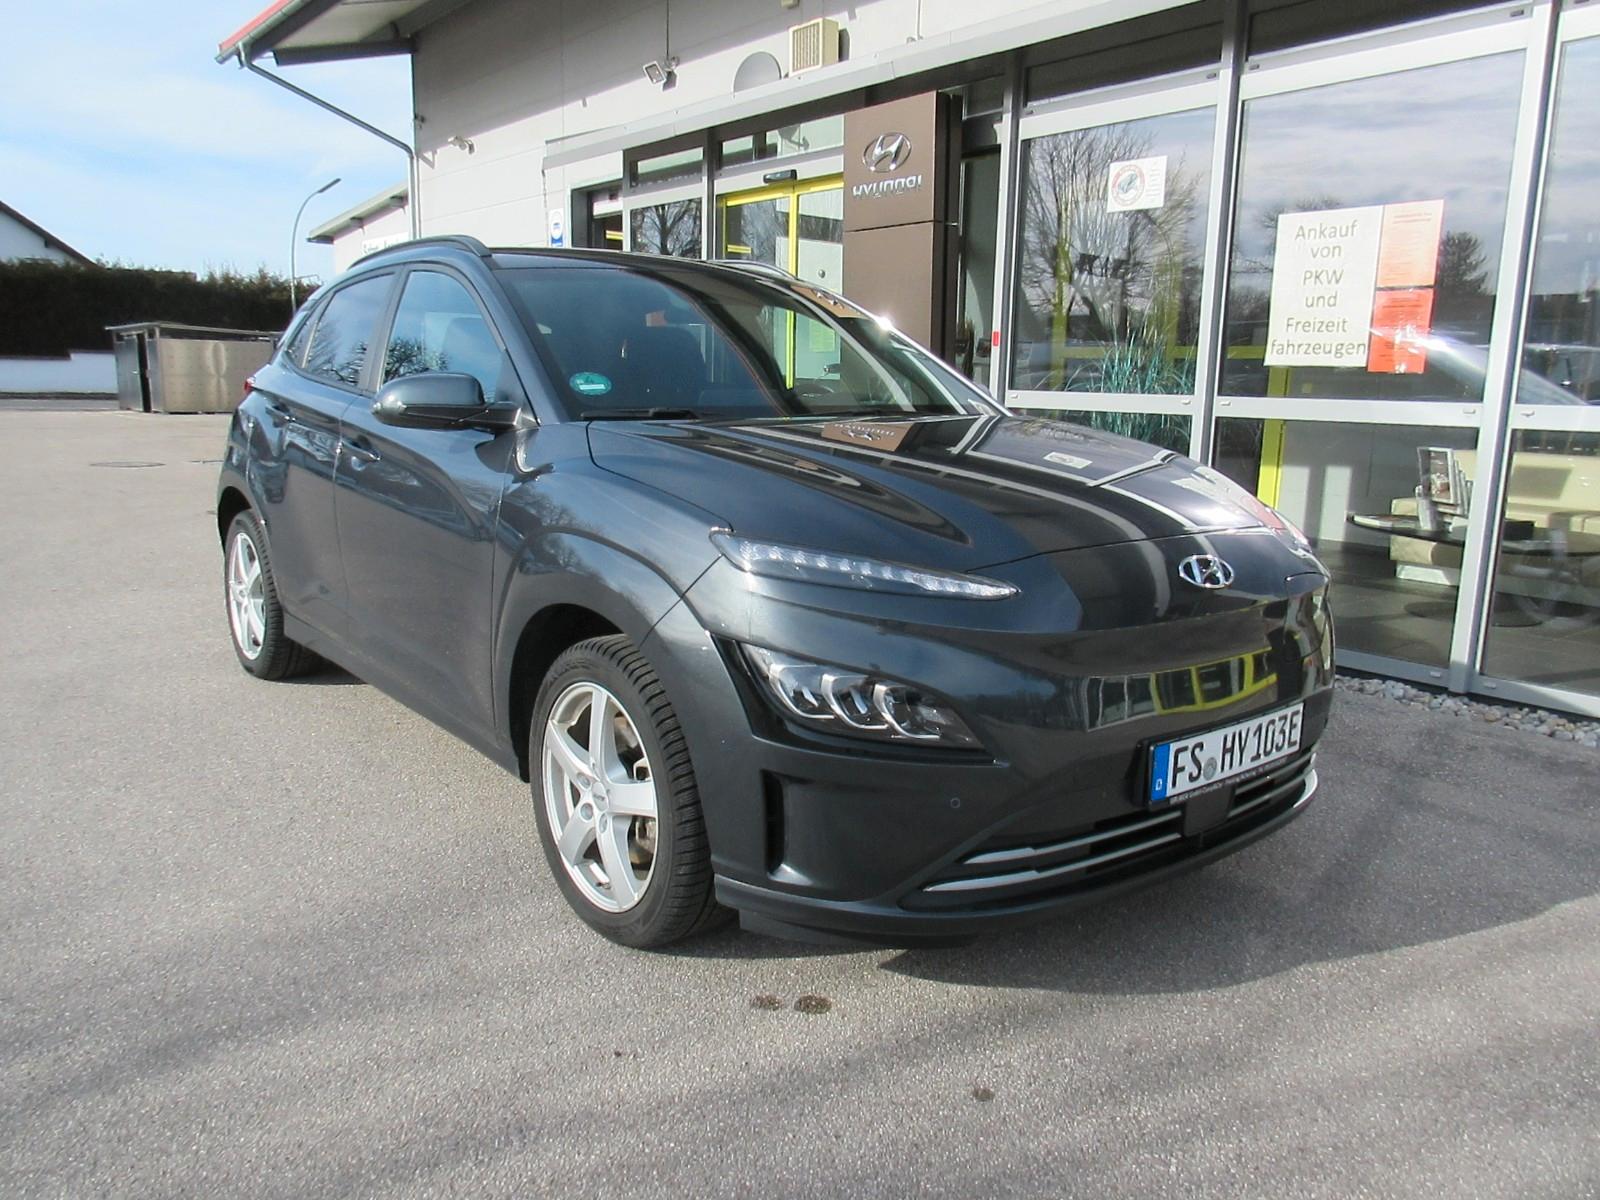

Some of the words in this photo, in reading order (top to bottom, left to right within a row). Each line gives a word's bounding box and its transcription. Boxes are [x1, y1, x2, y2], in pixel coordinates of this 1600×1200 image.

[1294, 219, 1358, 241] Ankauf
[1311, 244, 1342, 259] von
[1303, 269, 1344, 286] PKW
[1305, 291, 1338, 309] und
[1286, 317, 1348, 333] Freizeit
[1270, 339, 1367, 359] fahrzeugen
[1171, 741, 1205, 789] FS
